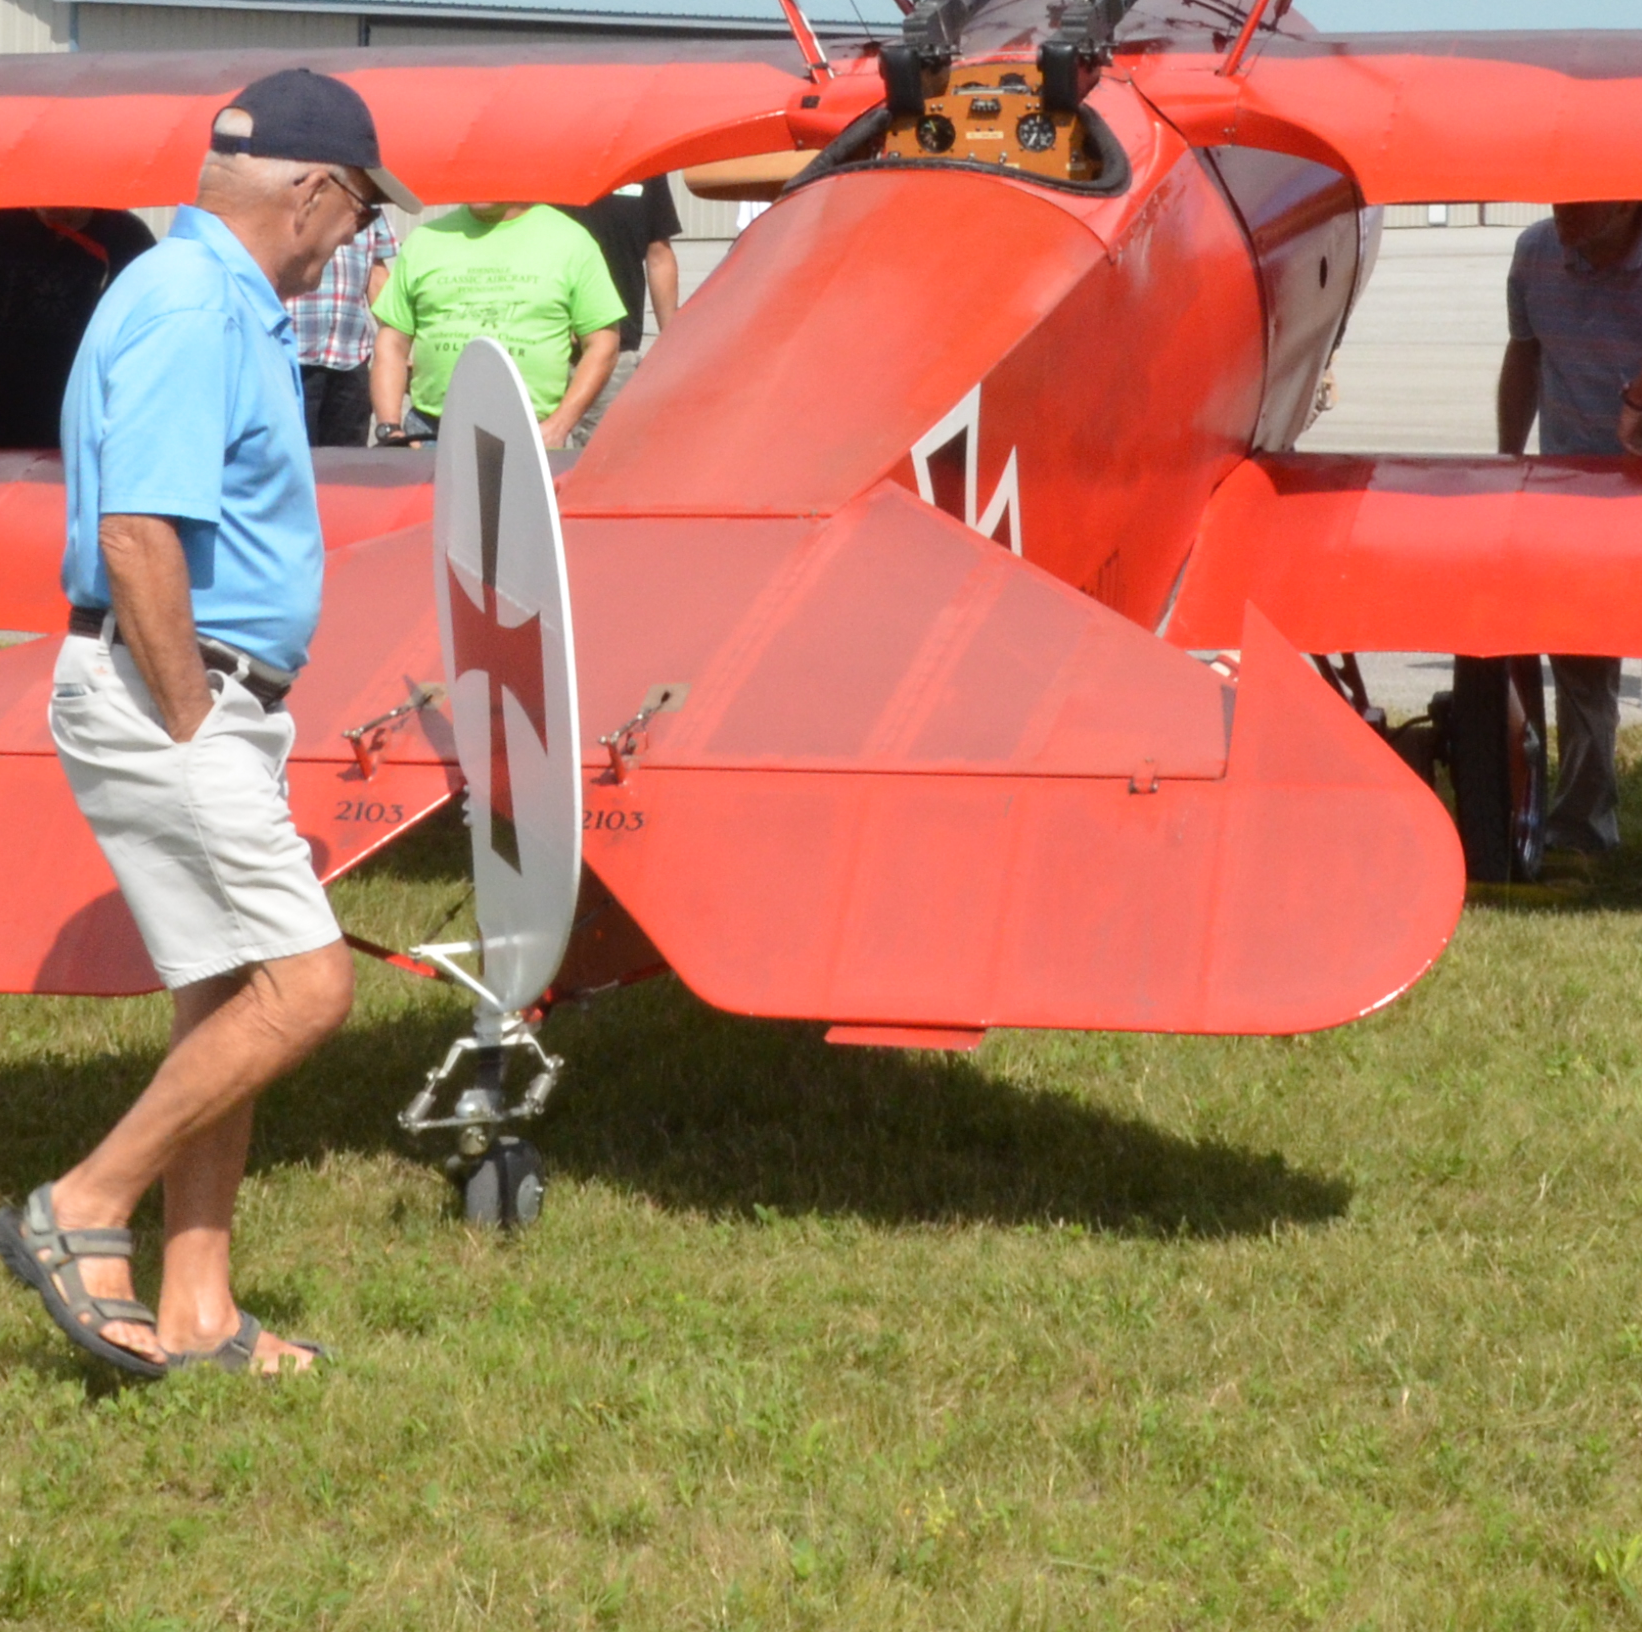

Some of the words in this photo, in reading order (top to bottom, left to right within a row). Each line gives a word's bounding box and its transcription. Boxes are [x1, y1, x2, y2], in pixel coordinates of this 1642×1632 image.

[437, 275, 479, 285] CLASSIC
[486, 274, 539, 284] AIRCRAFT
[335, 800, 404, 824] 2103
